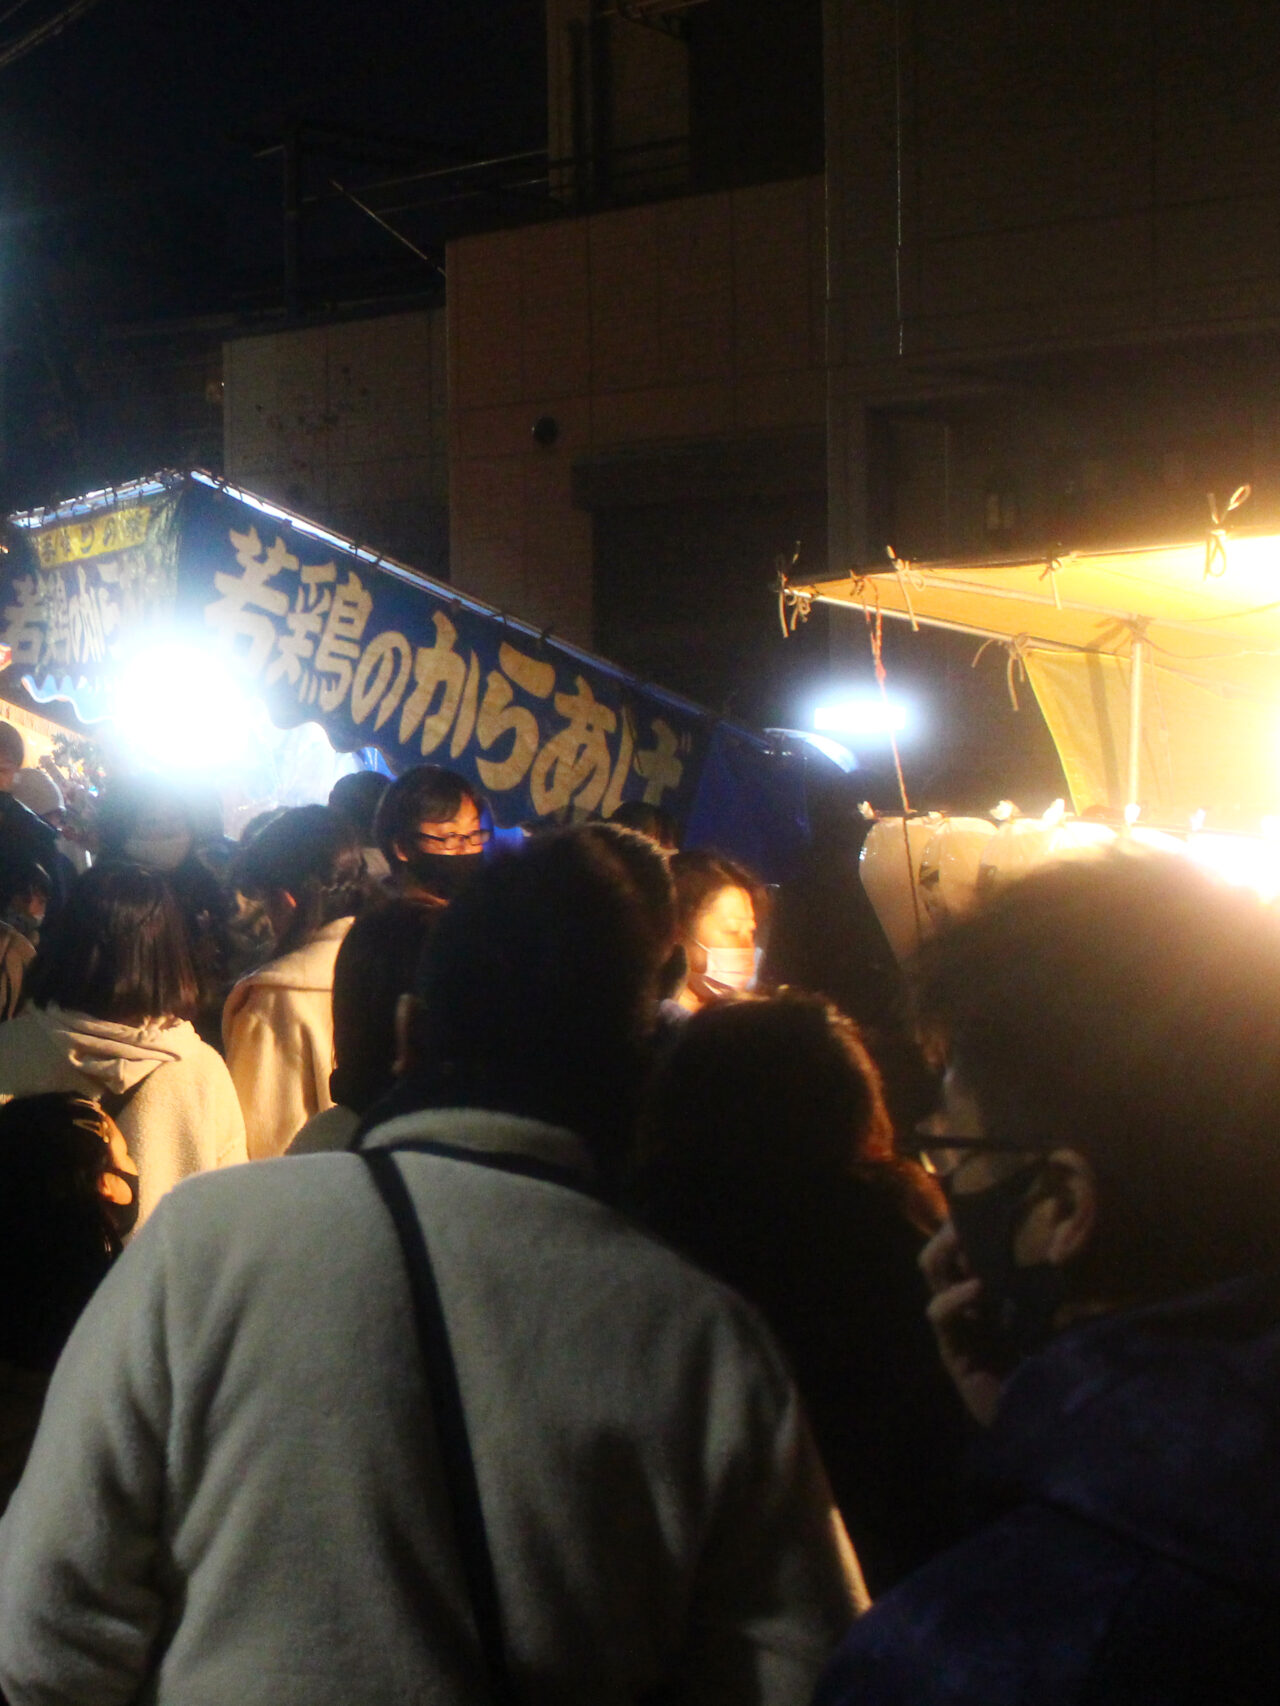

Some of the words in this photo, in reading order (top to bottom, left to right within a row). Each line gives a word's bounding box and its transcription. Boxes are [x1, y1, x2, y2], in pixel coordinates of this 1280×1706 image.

[204, 526, 693, 818] 若鶏のからあげ
